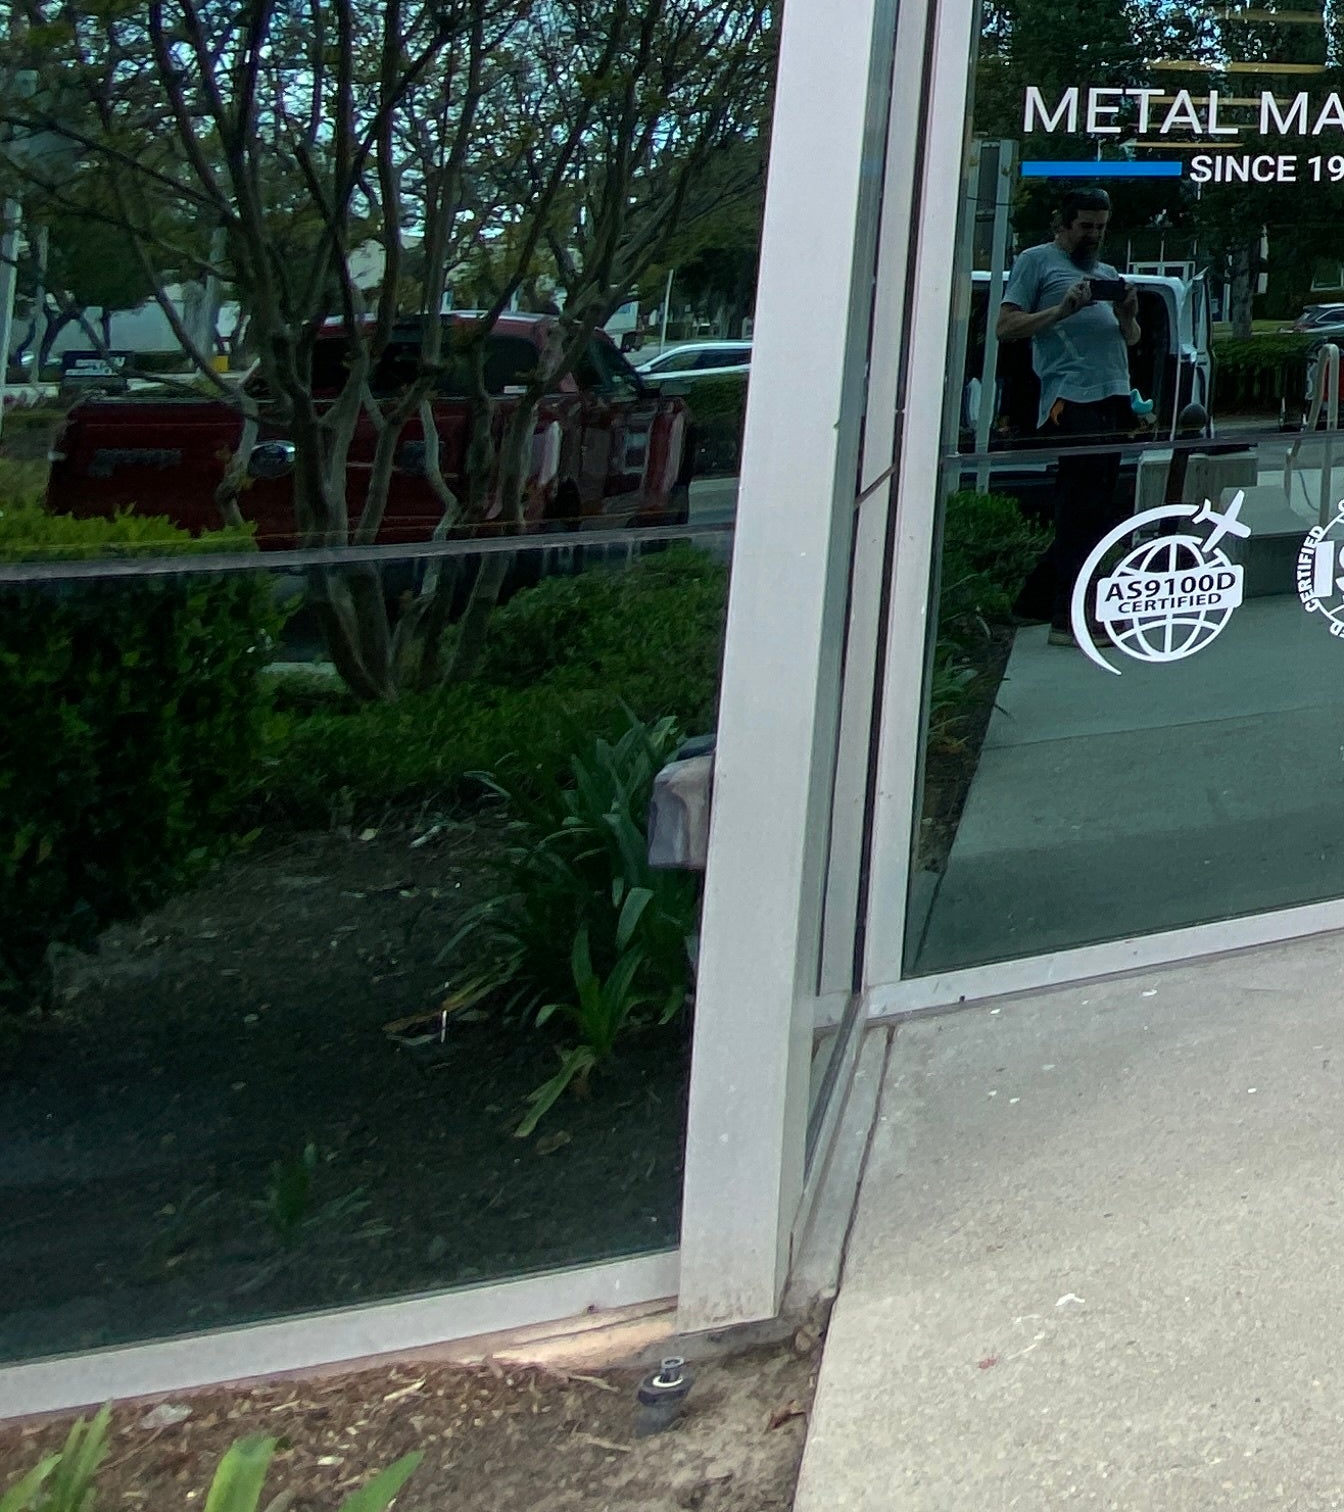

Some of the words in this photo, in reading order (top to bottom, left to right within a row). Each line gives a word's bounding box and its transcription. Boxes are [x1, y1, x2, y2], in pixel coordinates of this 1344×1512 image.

[1023, 86, 1238, 134] METAL
[1190, 156, 1297, 183] SINCE
[1296, 524, 1325, 613] CERTIFIED
[1105, 571, 1236, 602] AS9100D
[1118, 593, 1222, 614] CERTIFIED
